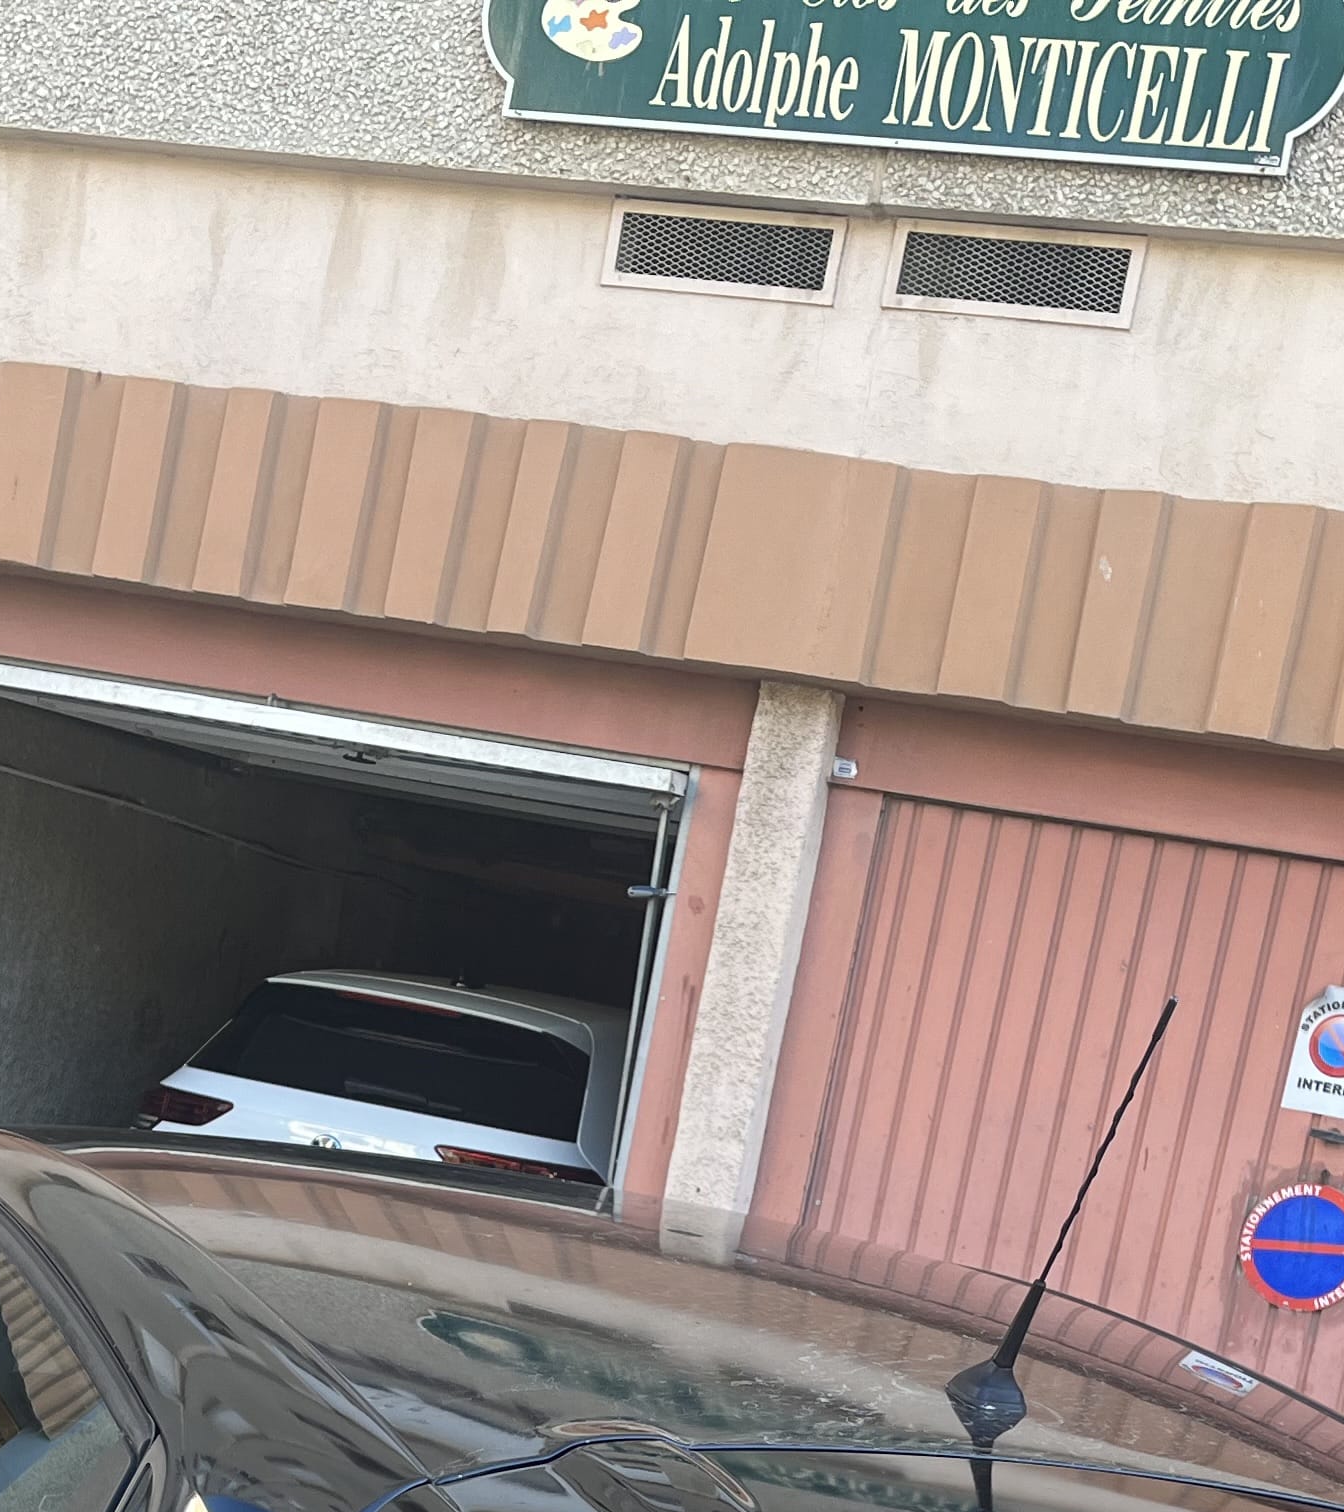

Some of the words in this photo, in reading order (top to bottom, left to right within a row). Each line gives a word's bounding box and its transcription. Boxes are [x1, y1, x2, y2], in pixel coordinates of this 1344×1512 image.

[648, 14, 859, 128] Adolphe
[882, 28, 1291, 153] MONTICELLI
[1240, 1184, 1323, 1262] STATIONNEMENT
